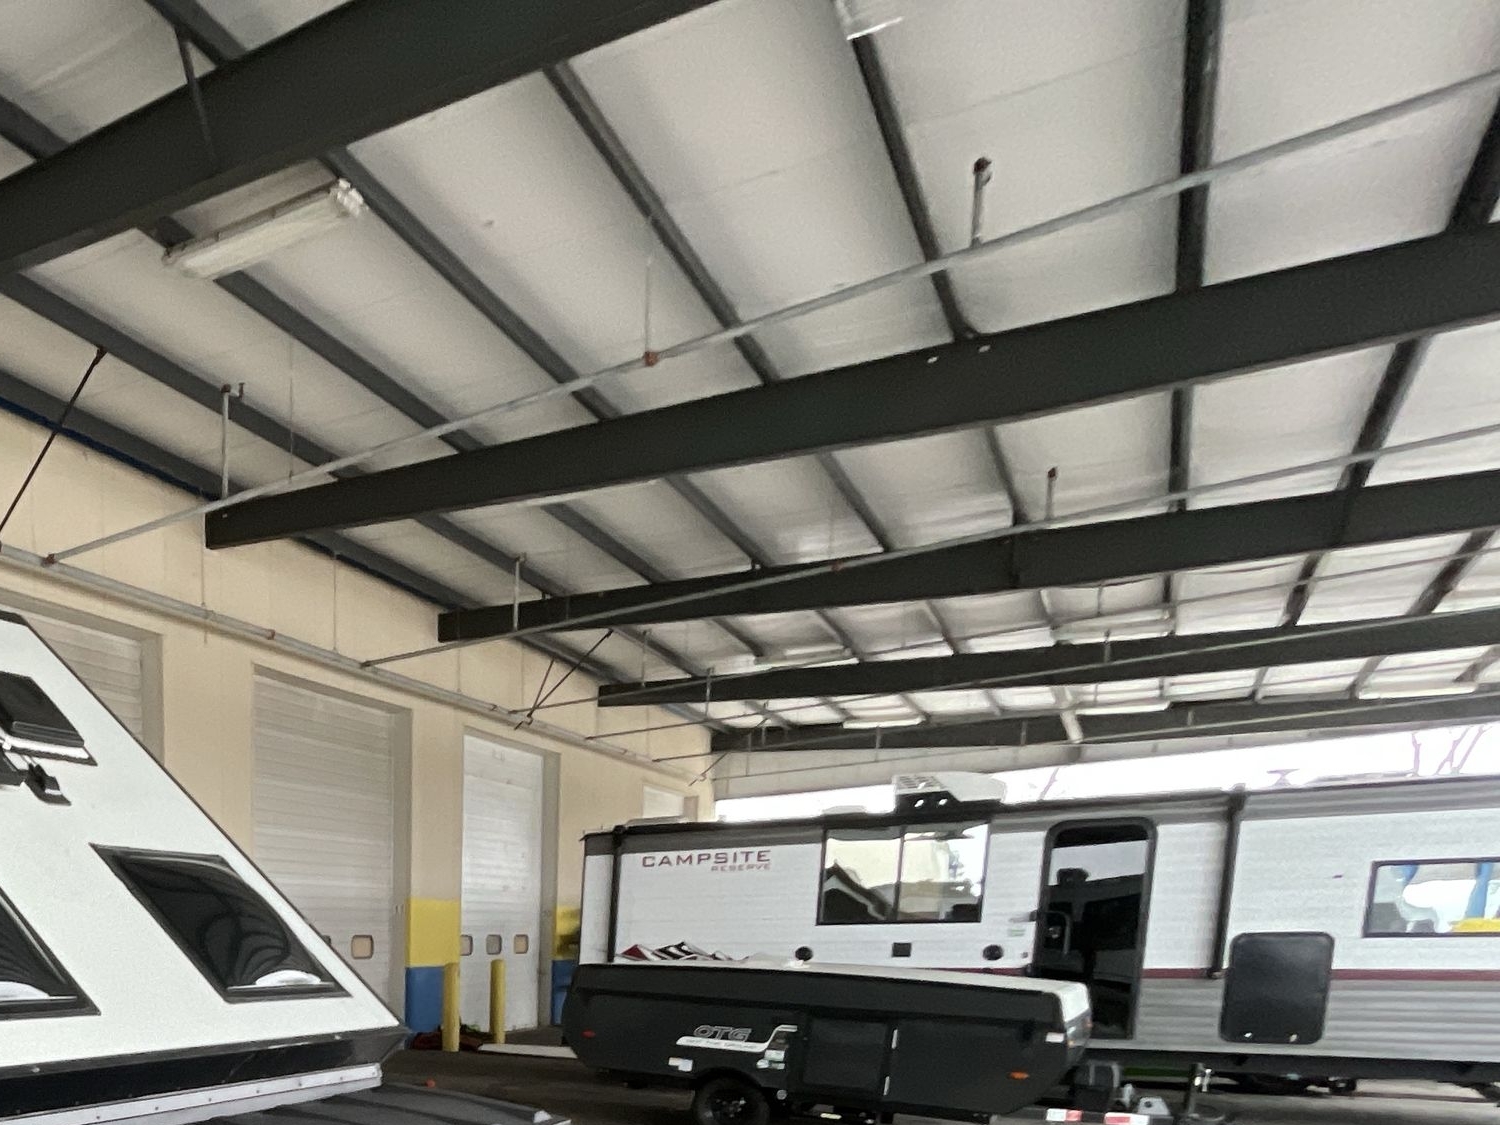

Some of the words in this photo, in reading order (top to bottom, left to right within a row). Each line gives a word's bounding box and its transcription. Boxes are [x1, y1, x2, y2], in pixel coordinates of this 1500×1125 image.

[642, 850, 771, 868] CAMPSITE
[711, 864, 771, 872] RESERVE
[693, 1025, 752, 1042] OTG
